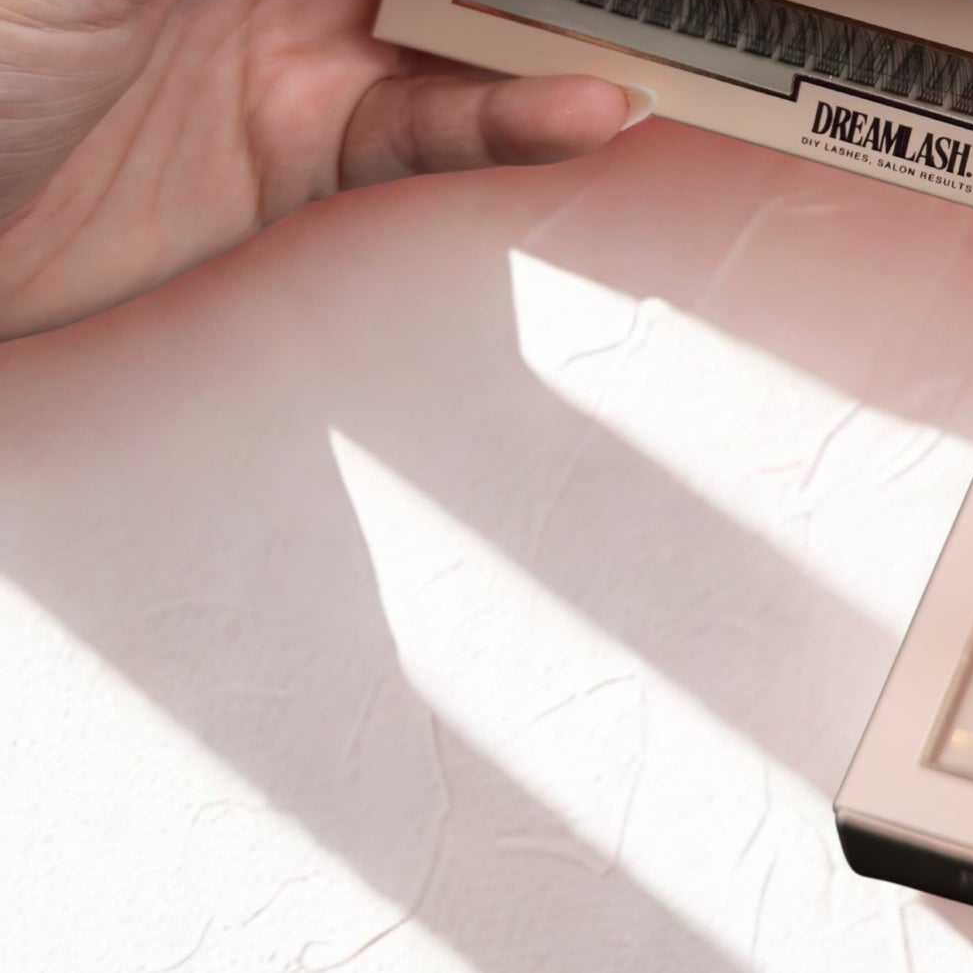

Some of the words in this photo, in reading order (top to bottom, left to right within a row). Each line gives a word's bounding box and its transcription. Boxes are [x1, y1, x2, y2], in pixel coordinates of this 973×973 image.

[801, 135, 821, 149] DIY
[824, 142, 873, 166] LASHES,
[877, 157, 917, 177] SALON
[920, 170, 973, 194] RESULTS
[811, 100, 973, 179] DREAMLASH.
